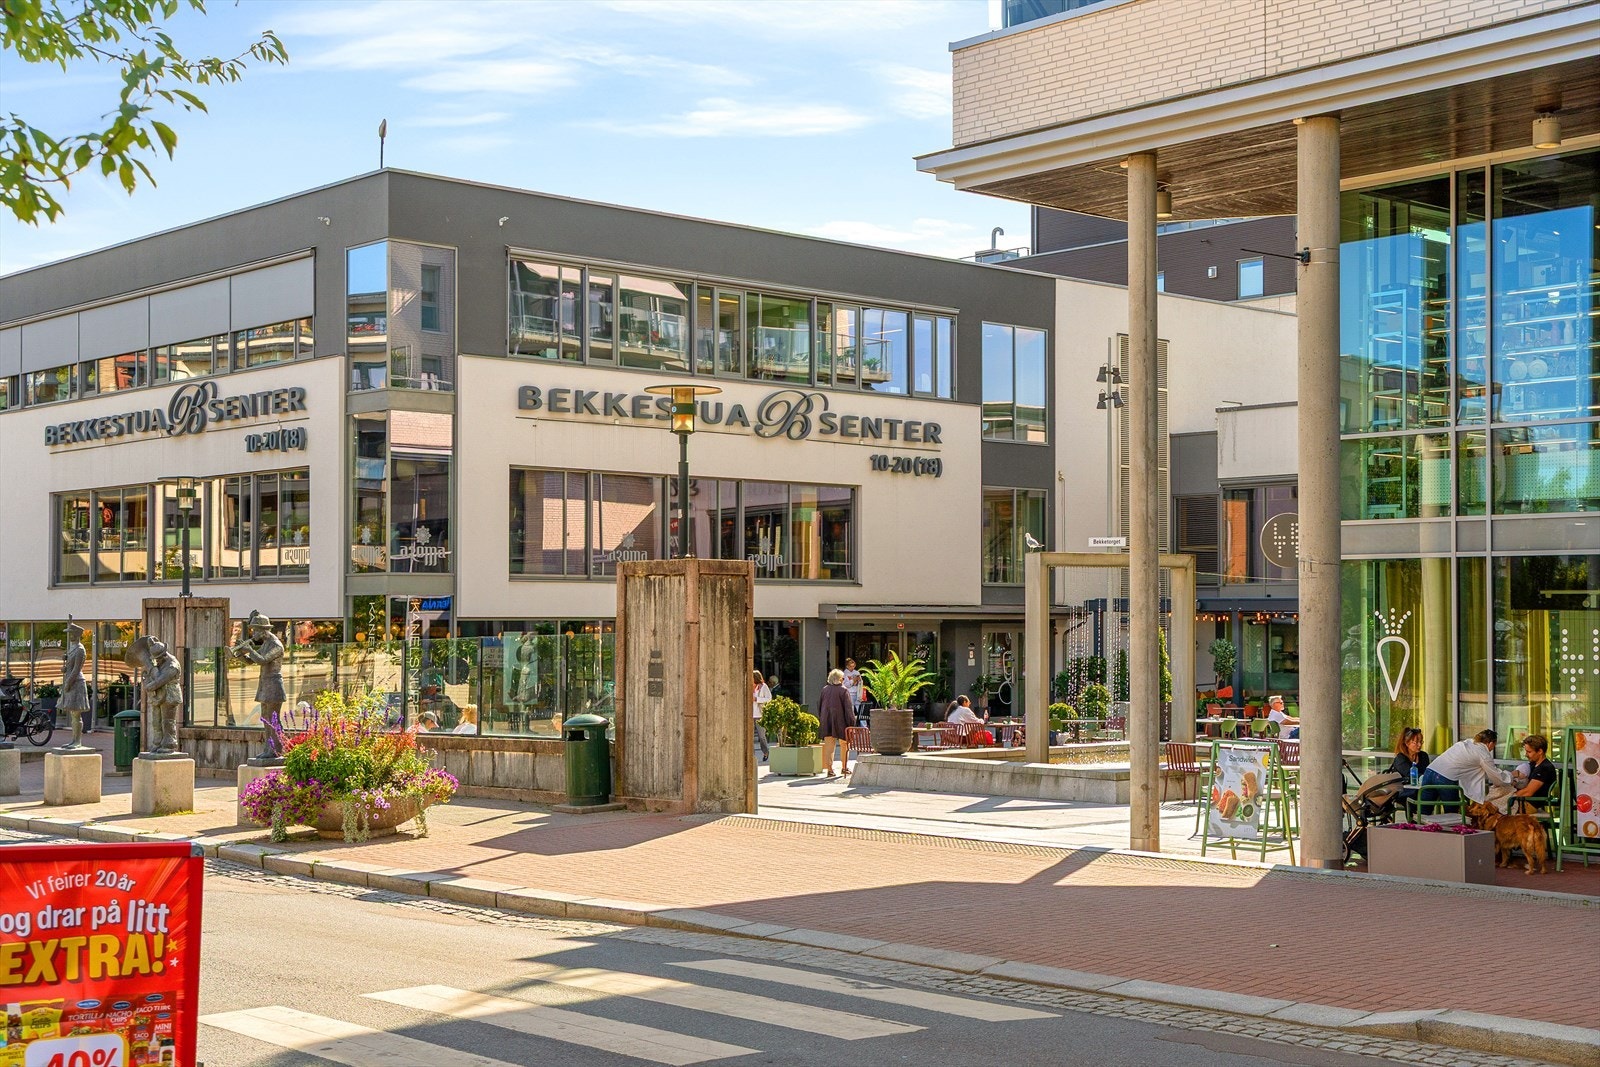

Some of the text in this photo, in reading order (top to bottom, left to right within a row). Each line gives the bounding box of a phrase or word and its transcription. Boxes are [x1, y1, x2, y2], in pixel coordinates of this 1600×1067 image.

[45, 408, 167, 446] BEKKESTUA
[208, 386, 308, 423] SENTER
[517, 385, 751, 428] BEKKESUA
[819, 412, 943, 444] SENTER
[1092, 538, 1122, 547] Bekketorget
[1228, 754, 1258, 764] Sandwich
[25, 869, 136, 900] Vi feirer 20 år
[0, 899, 170, 937] og drar på litt
[0, 931, 166, 986] EXTRA!
[105, 1010, 133, 1019] NACHO
[154, 1023, 172, 1031] MINI
